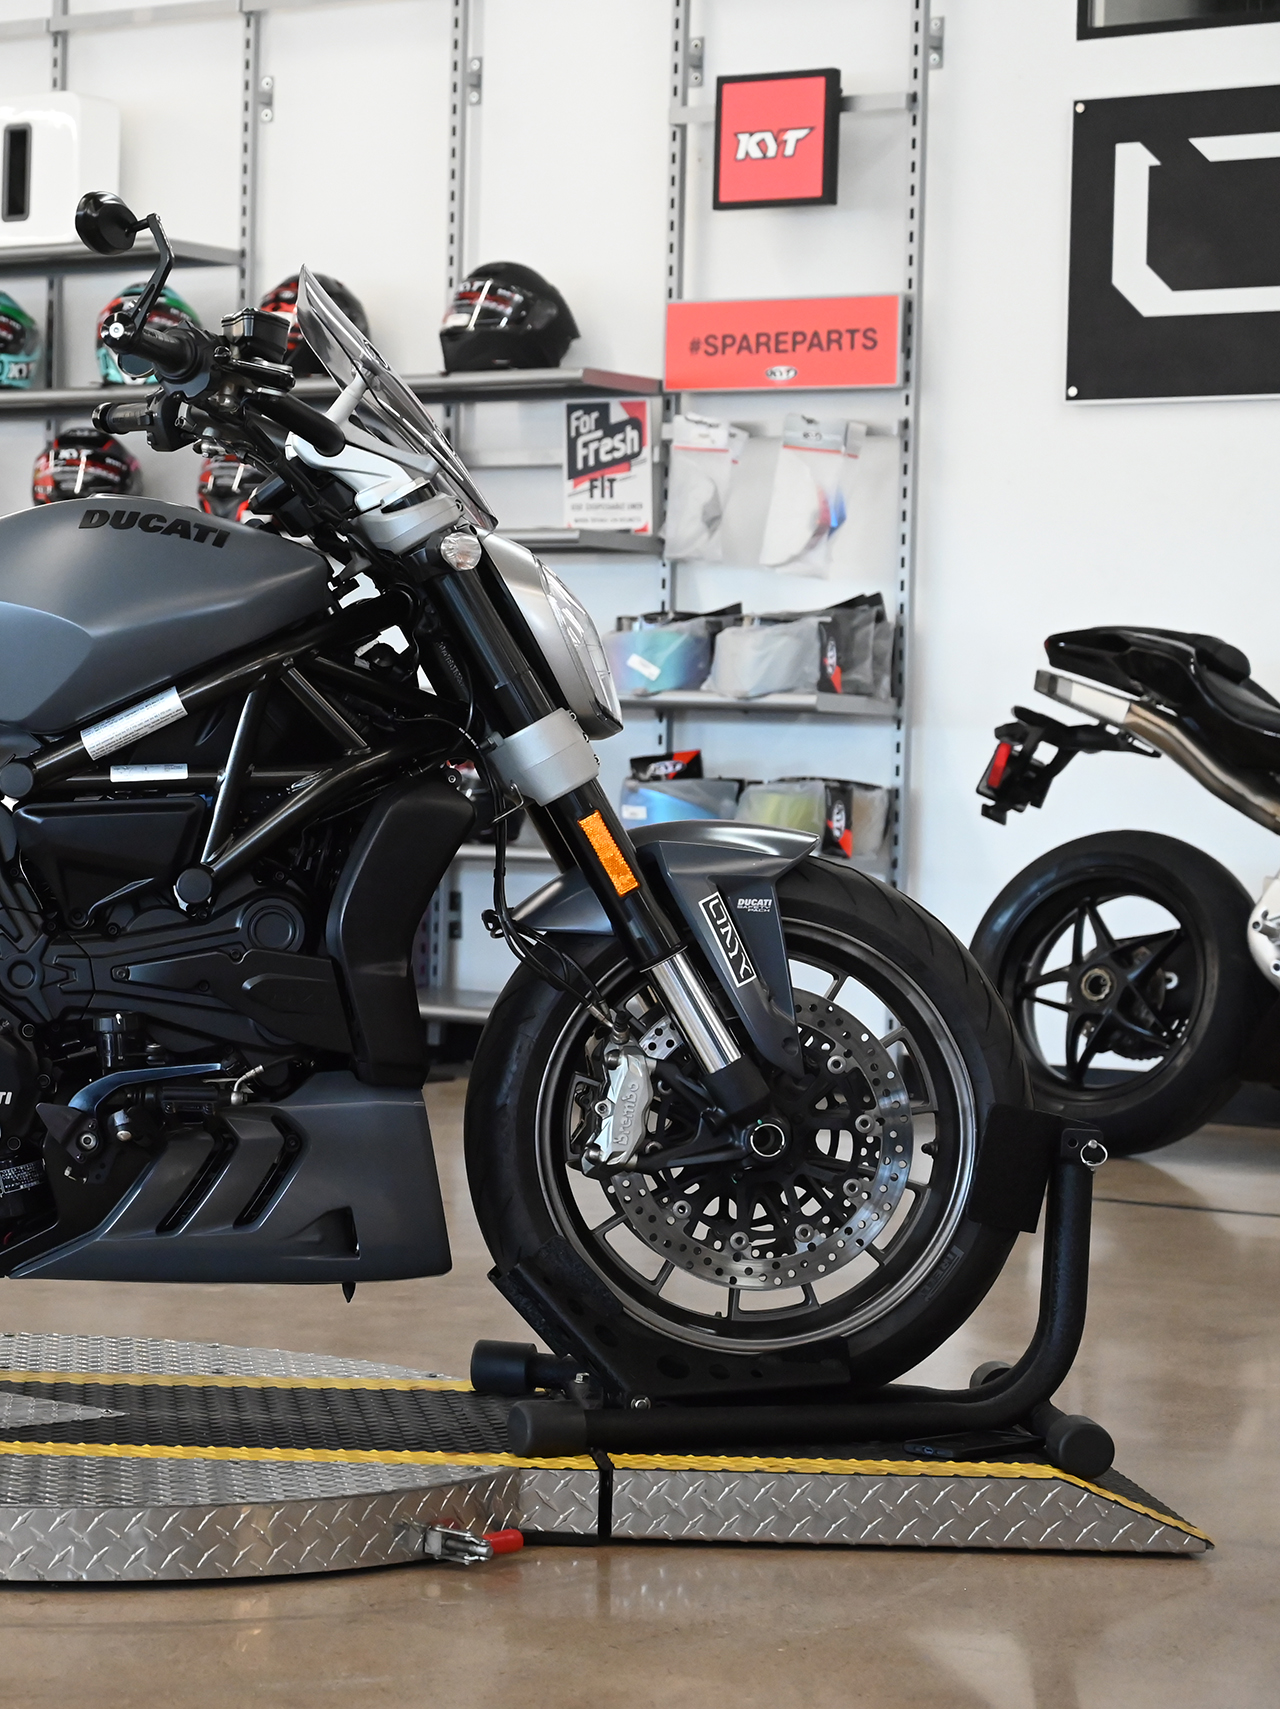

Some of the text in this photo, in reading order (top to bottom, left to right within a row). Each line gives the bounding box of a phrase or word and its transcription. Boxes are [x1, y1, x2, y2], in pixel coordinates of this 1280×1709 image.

[734, 127, 816, 161] KYT
[689, 327, 879, 357] #SPAREPARTS
[570, 409, 600, 438] For
[576, 424, 640, 471] Fresh
[78, 509, 231, 549] DUCATI
[737, 898, 772, 907] DUCATI
